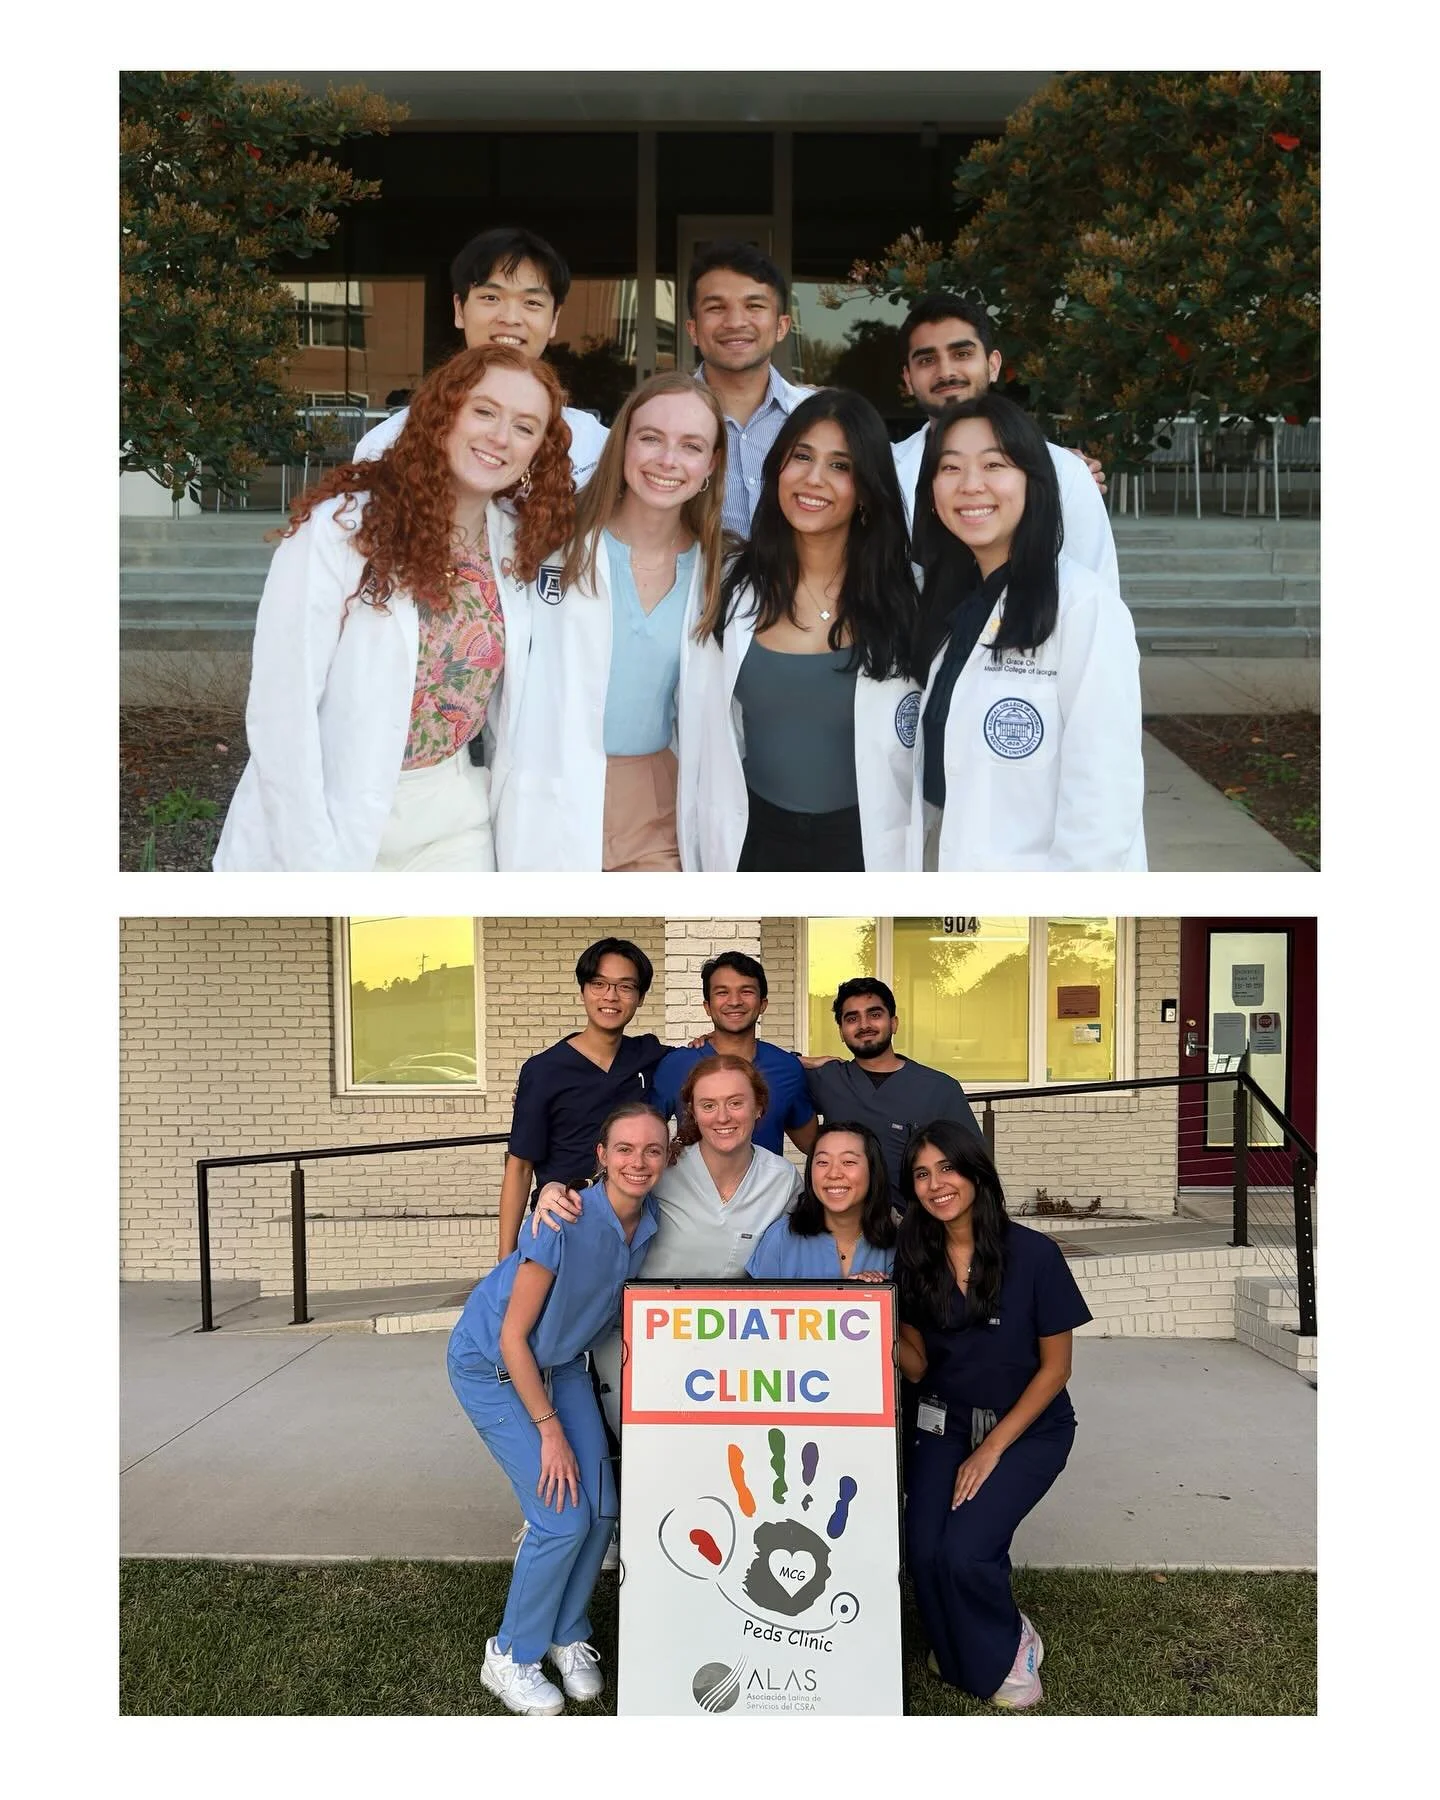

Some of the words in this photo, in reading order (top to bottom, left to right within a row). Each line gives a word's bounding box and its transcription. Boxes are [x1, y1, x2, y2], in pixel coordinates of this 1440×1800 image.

[1006, 658, 1024, 666] Grace
[1004, 665, 1027, 675] College
[1000, 701, 1024, 710] COLLEGE
[945, 916, 977, 933] 904
[646, 1308, 871, 1342] PEDIATRIC
[685, 1369, 830, 1403] CLINIC
[779, 1566, 806, 1581] MCG
[743, 1619, 783, 1642] Peds
[788, 1629, 833, 1652] Clinic
[746, 1668, 817, 1692] ALAS
[788, 1693, 810, 1702] Latina
[812, 1693, 822, 1702] de
[746, 1701, 779, 1711] Servicios
[781, 1702, 793, 1711] del
[794, 1702, 816, 1711] CSRA
